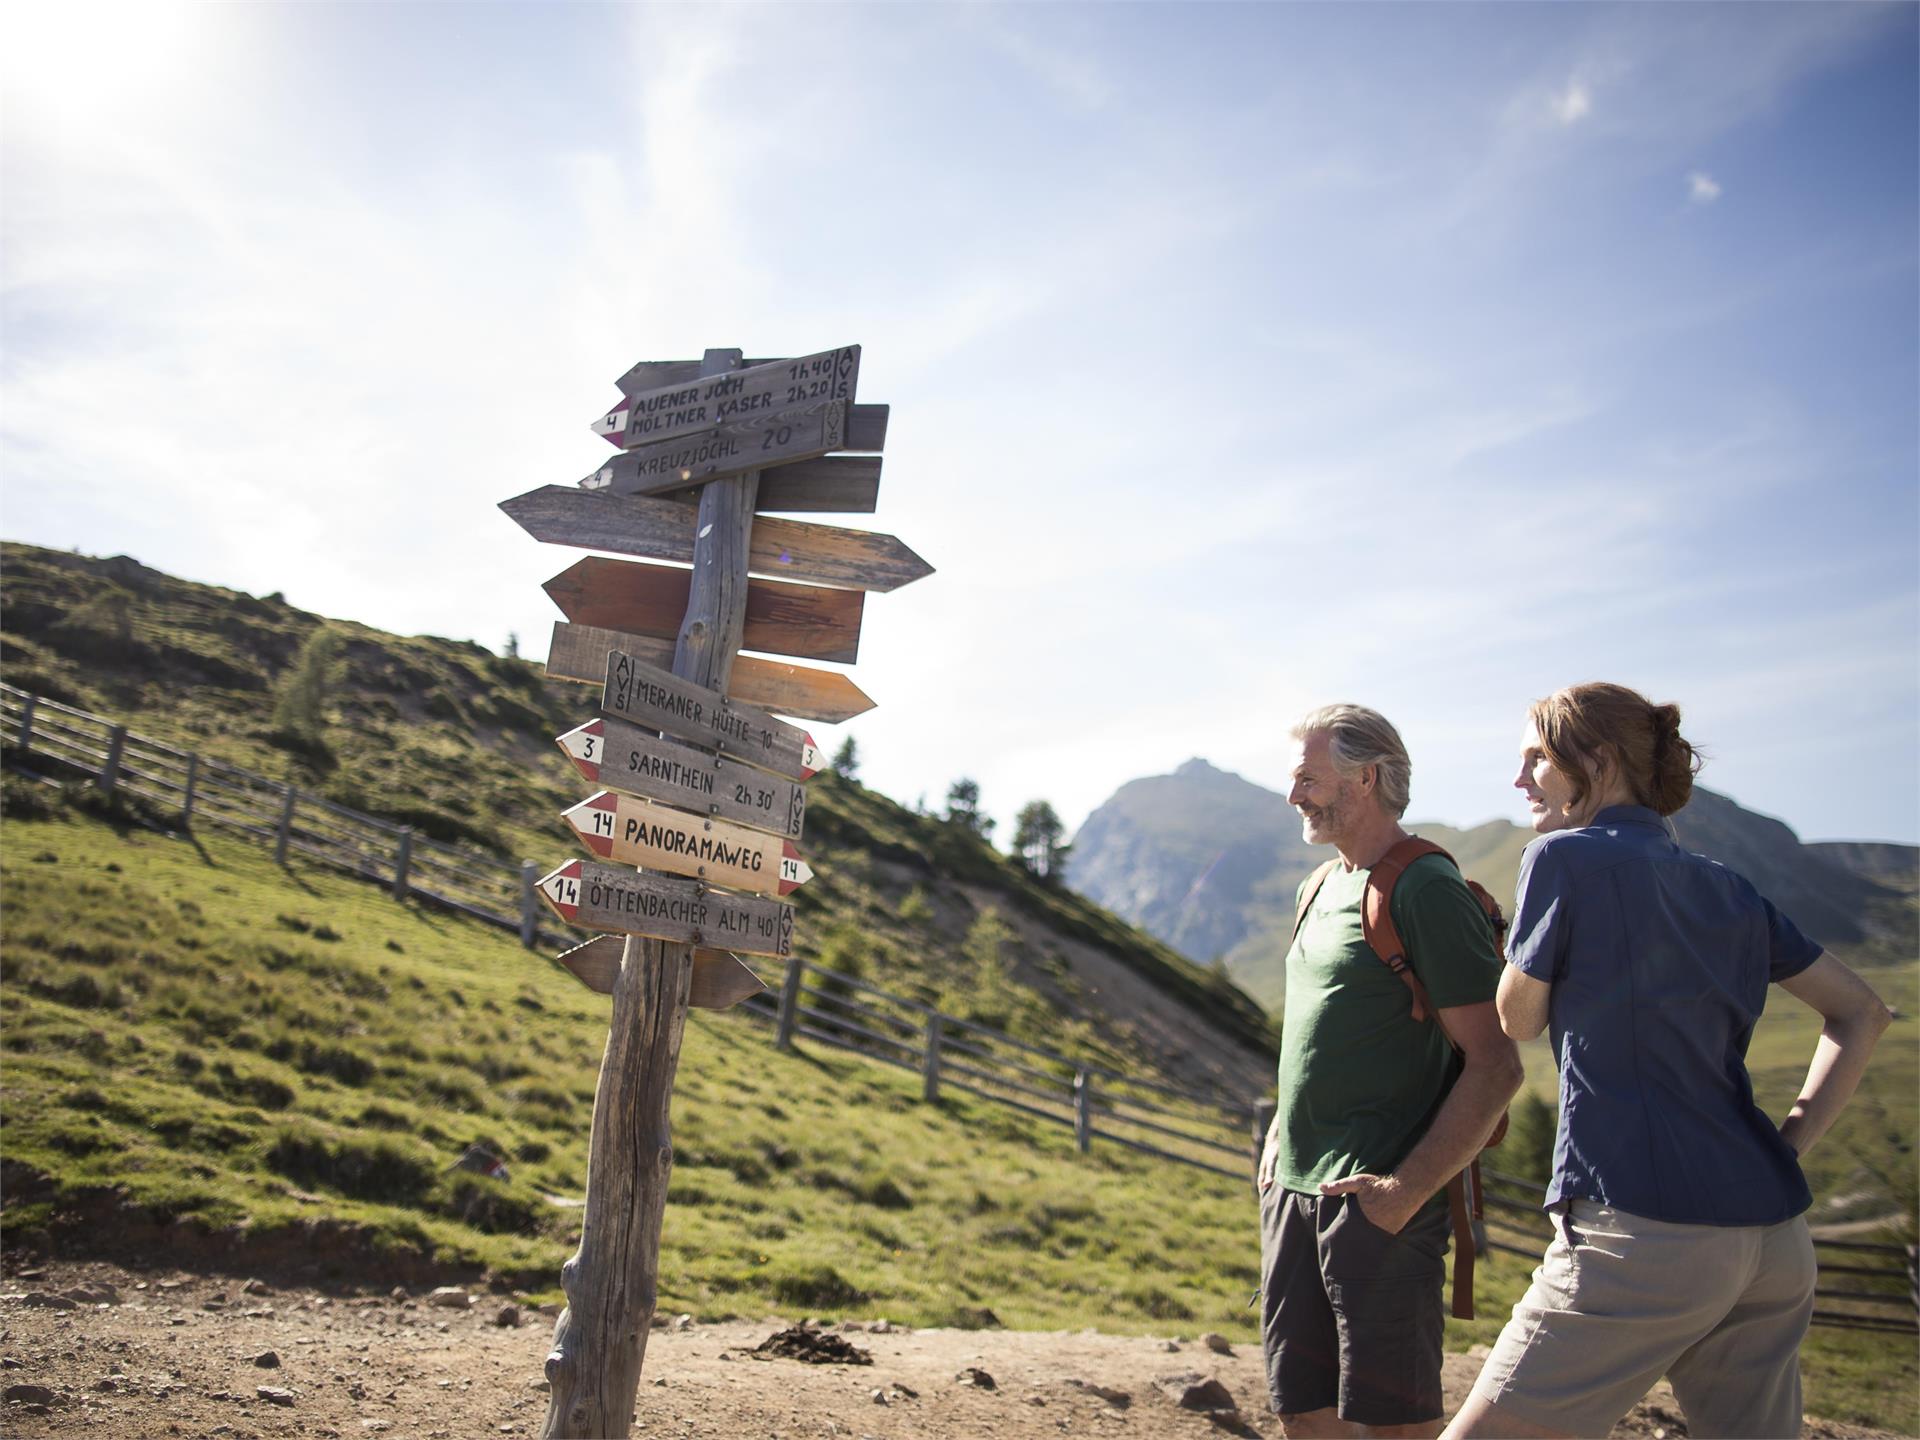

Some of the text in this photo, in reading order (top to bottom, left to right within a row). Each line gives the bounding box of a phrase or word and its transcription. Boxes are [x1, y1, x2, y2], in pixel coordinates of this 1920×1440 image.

[631, 407, 706, 435] MÖLTNER
[717, 392, 772, 417] KASER
[634, 388, 699, 416] AUENER
[704, 378, 744, 400] JOCH
[607, 415, 617, 430] 4
[637, 439, 739, 477] KREUZJÖCHL
[637, 680, 702, 722] MERANER
[711, 709, 749, 742] HÜTTE
[584, 737, 595, 759] 3
[806, 749, 814, 765] 3
[629, 751, 714, 795] SARNTHEIN
[735, 784, 752, 806] 2h
[593, 812, 612, 836] 14
[625, 818, 762, 872] PANORAMAWEG
[783, 860, 798, 880] 14
[555, 878, 576, 904] 14
[590, 876, 707, 926] ÖTTENBACHER
[718, 909, 749, 934] ALM
